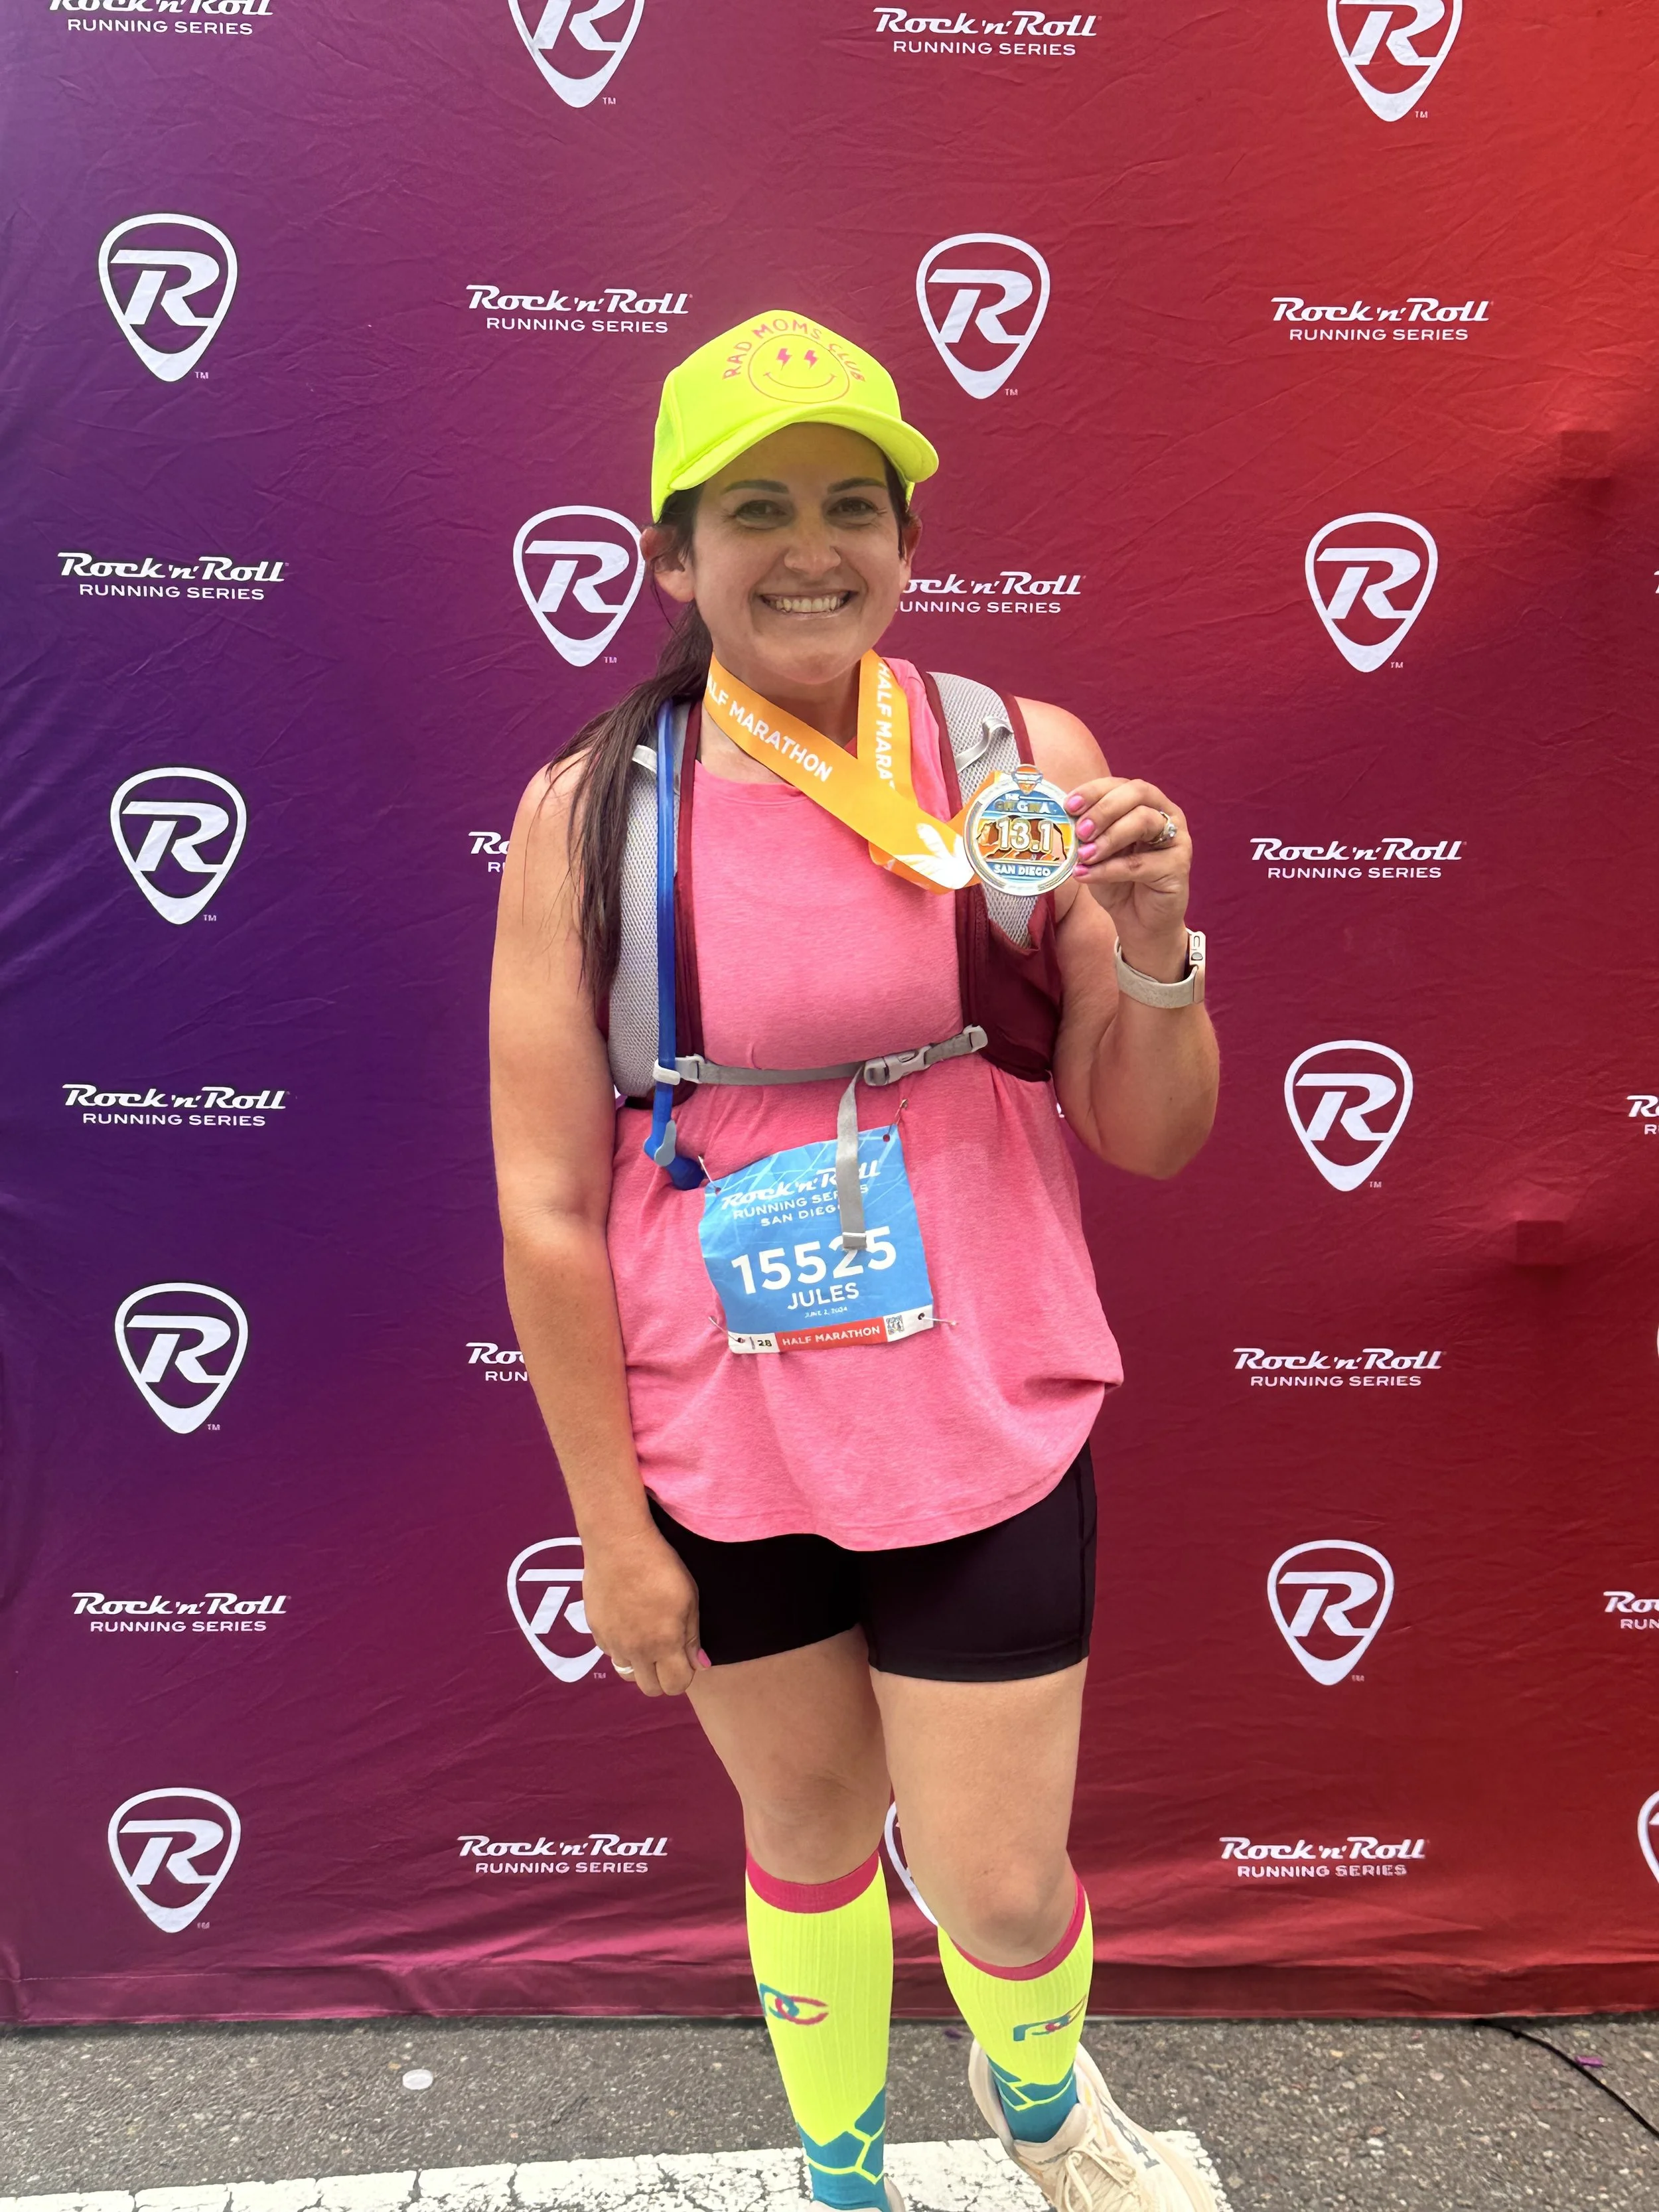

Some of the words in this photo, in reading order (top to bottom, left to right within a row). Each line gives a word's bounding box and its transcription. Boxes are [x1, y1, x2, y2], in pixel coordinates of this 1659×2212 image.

[68, 19, 167, 33] RUNNING
[175, 21, 252, 35] SERIES
[894, 41, 992, 54] RUNNING
[999, 43, 1075, 55] SERIES
[487, 318, 585, 331] RUNNING
[592, 321, 668, 332] SERIES
[1290, 329, 1386, 340] RUNNING
[1394, 329, 1467, 340] SERIES
[722, 341, 752, 380] RAD
[751, 319, 822, 340] MOMS
[80, 584, 180, 597] RUNNING
[187, 587, 264, 600] SERIES
[899, 601, 980, 613] UNNING
[987, 602, 1060, 613] SERIES
[877, 662, 892, 717] HALF
[707, 674, 729, 705] ALF
[729, 701, 833, 782] MARATHON
[875, 720, 895, 790] MARA
[997, 816, 1052, 853] 13.1
[993, 865, 1015, 875] SAN
[1018, 867, 1051, 877] DIEGO
[1268, 868, 1362, 878] RUNNING
[1368, 867, 1441, 878] SERIES
[84, 1114, 182, 1125] RUNNING
[189, 1115, 265, 1126] SERIES
[816, 1159, 881, 1188] Rll
[733, 1197, 807, 1220] RUNNING
[812, 1184, 869, 1204] SERS
[761, 1213, 792, 1226] SAN
[799, 1204, 840, 1219] DIEG
[731, 1226, 896, 1294] 15525
[788, 1282, 859, 1310] JULES
[782, 1337, 811, 1346] HALF
[815, 1326, 880, 1343] MARATHON
[1251, 1376, 1343, 1386] RUNNING
[1350, 1376, 1421, 1386] SERIES
[91, 1621, 186, 1631] RUNNING
[192, 1621, 266, 1631] SERIES
[476, 1862, 569, 1873] RUNNING
[576, 1862, 648, 1872] SERIES
[1238, 1866, 1329, 1878] RUNNING
[1336, 1865, 1406, 1876] SERIES
